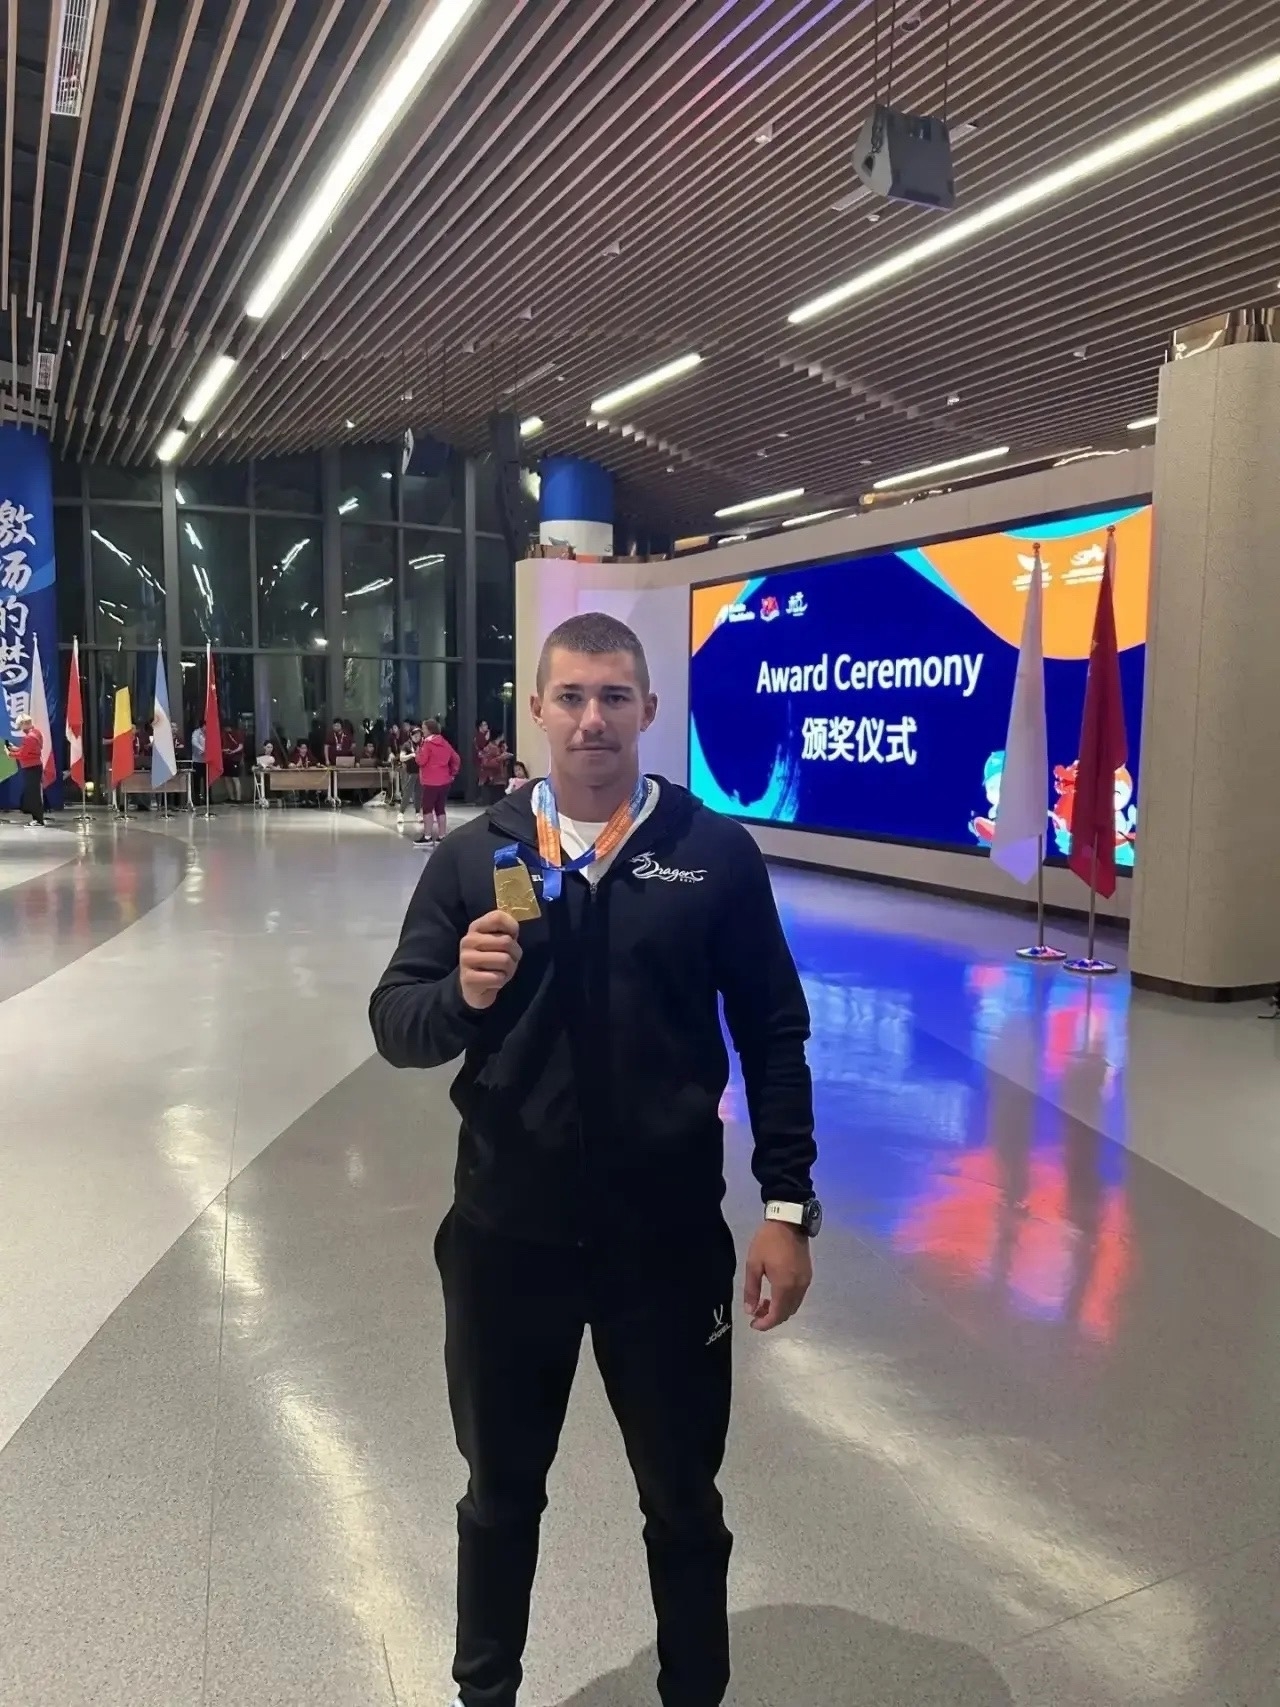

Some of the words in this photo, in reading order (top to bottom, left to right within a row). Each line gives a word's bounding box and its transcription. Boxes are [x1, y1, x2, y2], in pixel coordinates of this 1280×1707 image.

[756, 653, 828, 693] Award
[834, 653, 984, 697] Ceremony
[801, 716, 918, 766] 颁奖仪式
[631, 851, 708, 882] Dragon
